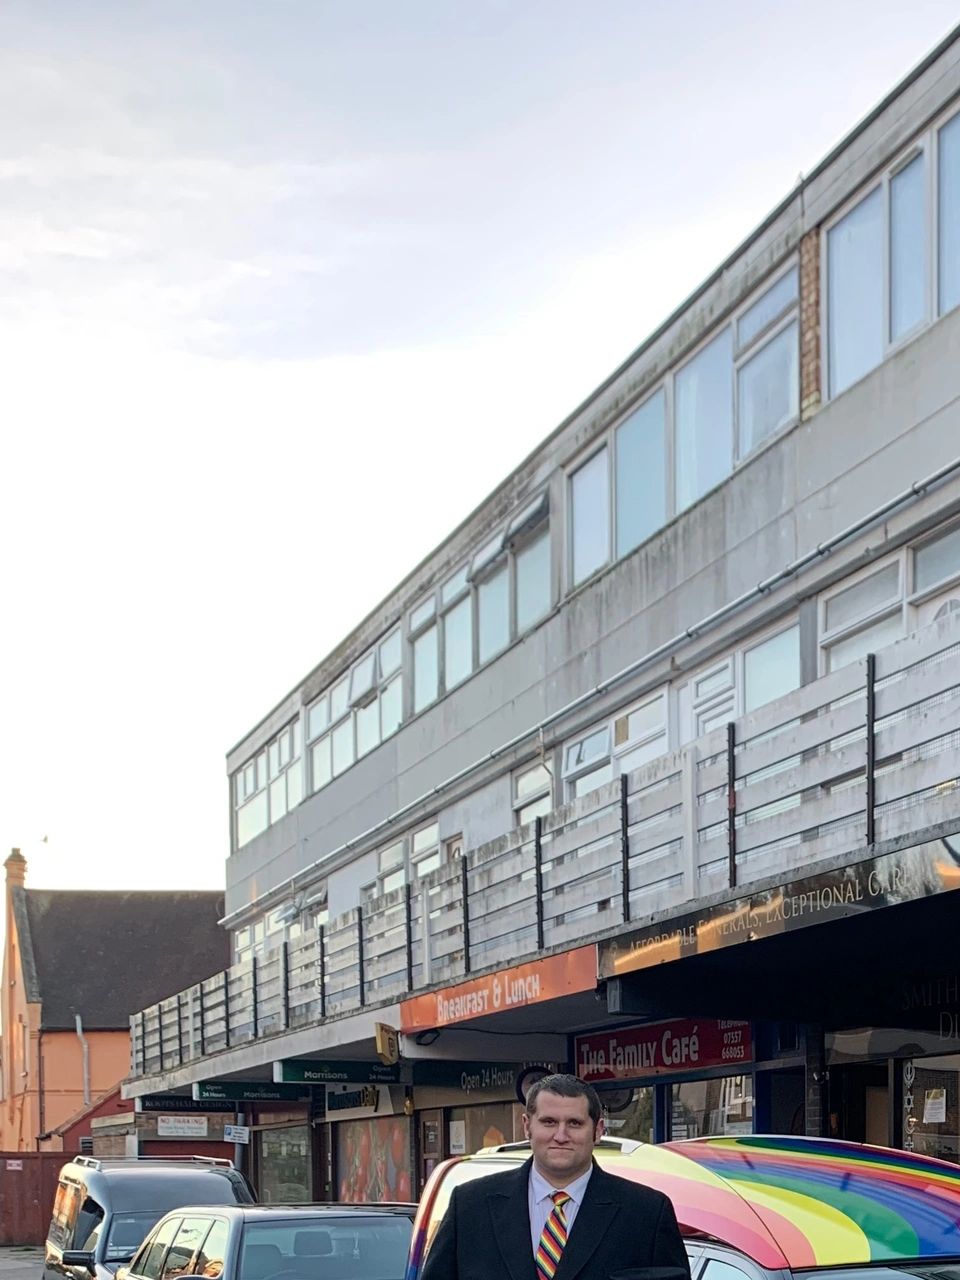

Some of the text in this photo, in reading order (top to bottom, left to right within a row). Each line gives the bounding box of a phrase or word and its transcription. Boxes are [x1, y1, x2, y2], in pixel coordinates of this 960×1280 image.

[766, 879, 863, 923] EXCEPTIONAL
[492, 978, 501, 1008] &
[902, 974, 958, 1010] SMITH
[661, 1025, 699, 1066] Café
[304, 1071, 348, 1080] Morrisons
[461, 1067, 514, 1095] Open 24 Hours
[243, 1091, 280, 1099] Morrisons
